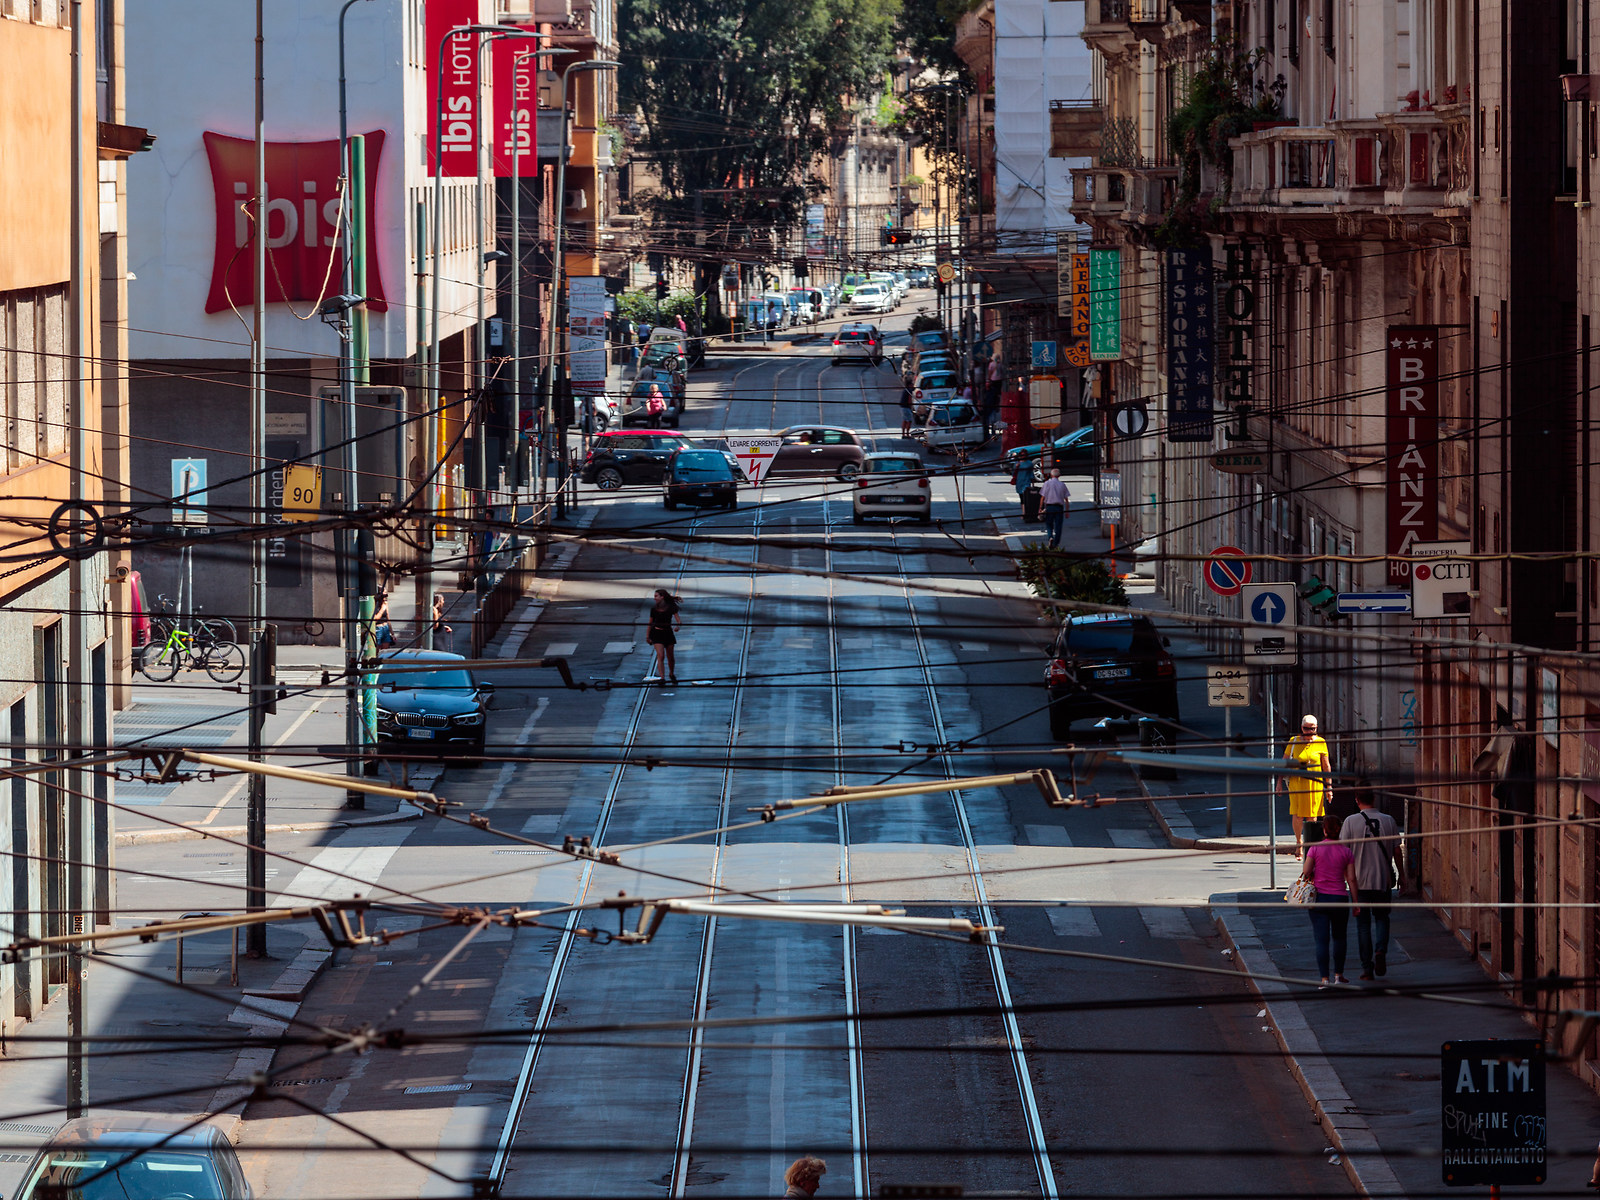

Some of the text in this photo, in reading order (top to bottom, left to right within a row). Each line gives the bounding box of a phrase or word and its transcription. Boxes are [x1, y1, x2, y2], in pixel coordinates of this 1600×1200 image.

[441, 17, 473, 152] ibis HOTEL
[504, 108, 531, 156] ibis
[233, 180, 353, 248] ibis
[1075, 257, 1089, 334] MERANO
[1107, 251, 1117, 311] CINESE
[1095, 251, 1104, 352] RISTORANTE
[1172, 251, 1188, 414] RISTORANTE
[1066, 348, 1087, 365] HOT
[730, 439, 780, 448] LEVARE CORRENTE
[1215, 455, 1263, 466] SIENA
[1397, 357, 1427, 556] BRIANZA
[269, 470, 284, 526] kichen
[293, 487, 314, 504] 90
[1101, 478, 1120, 492] TRAM
[1390, 561, 1410, 577] HO
[1215, 670, 1242, 680] 0-24
[1455, 1058, 1534, 1093] A.T.M.
[1478, 1112, 1508, 1129] FINE
[1444, 1147, 1544, 1164] RALLENTAMENTO
